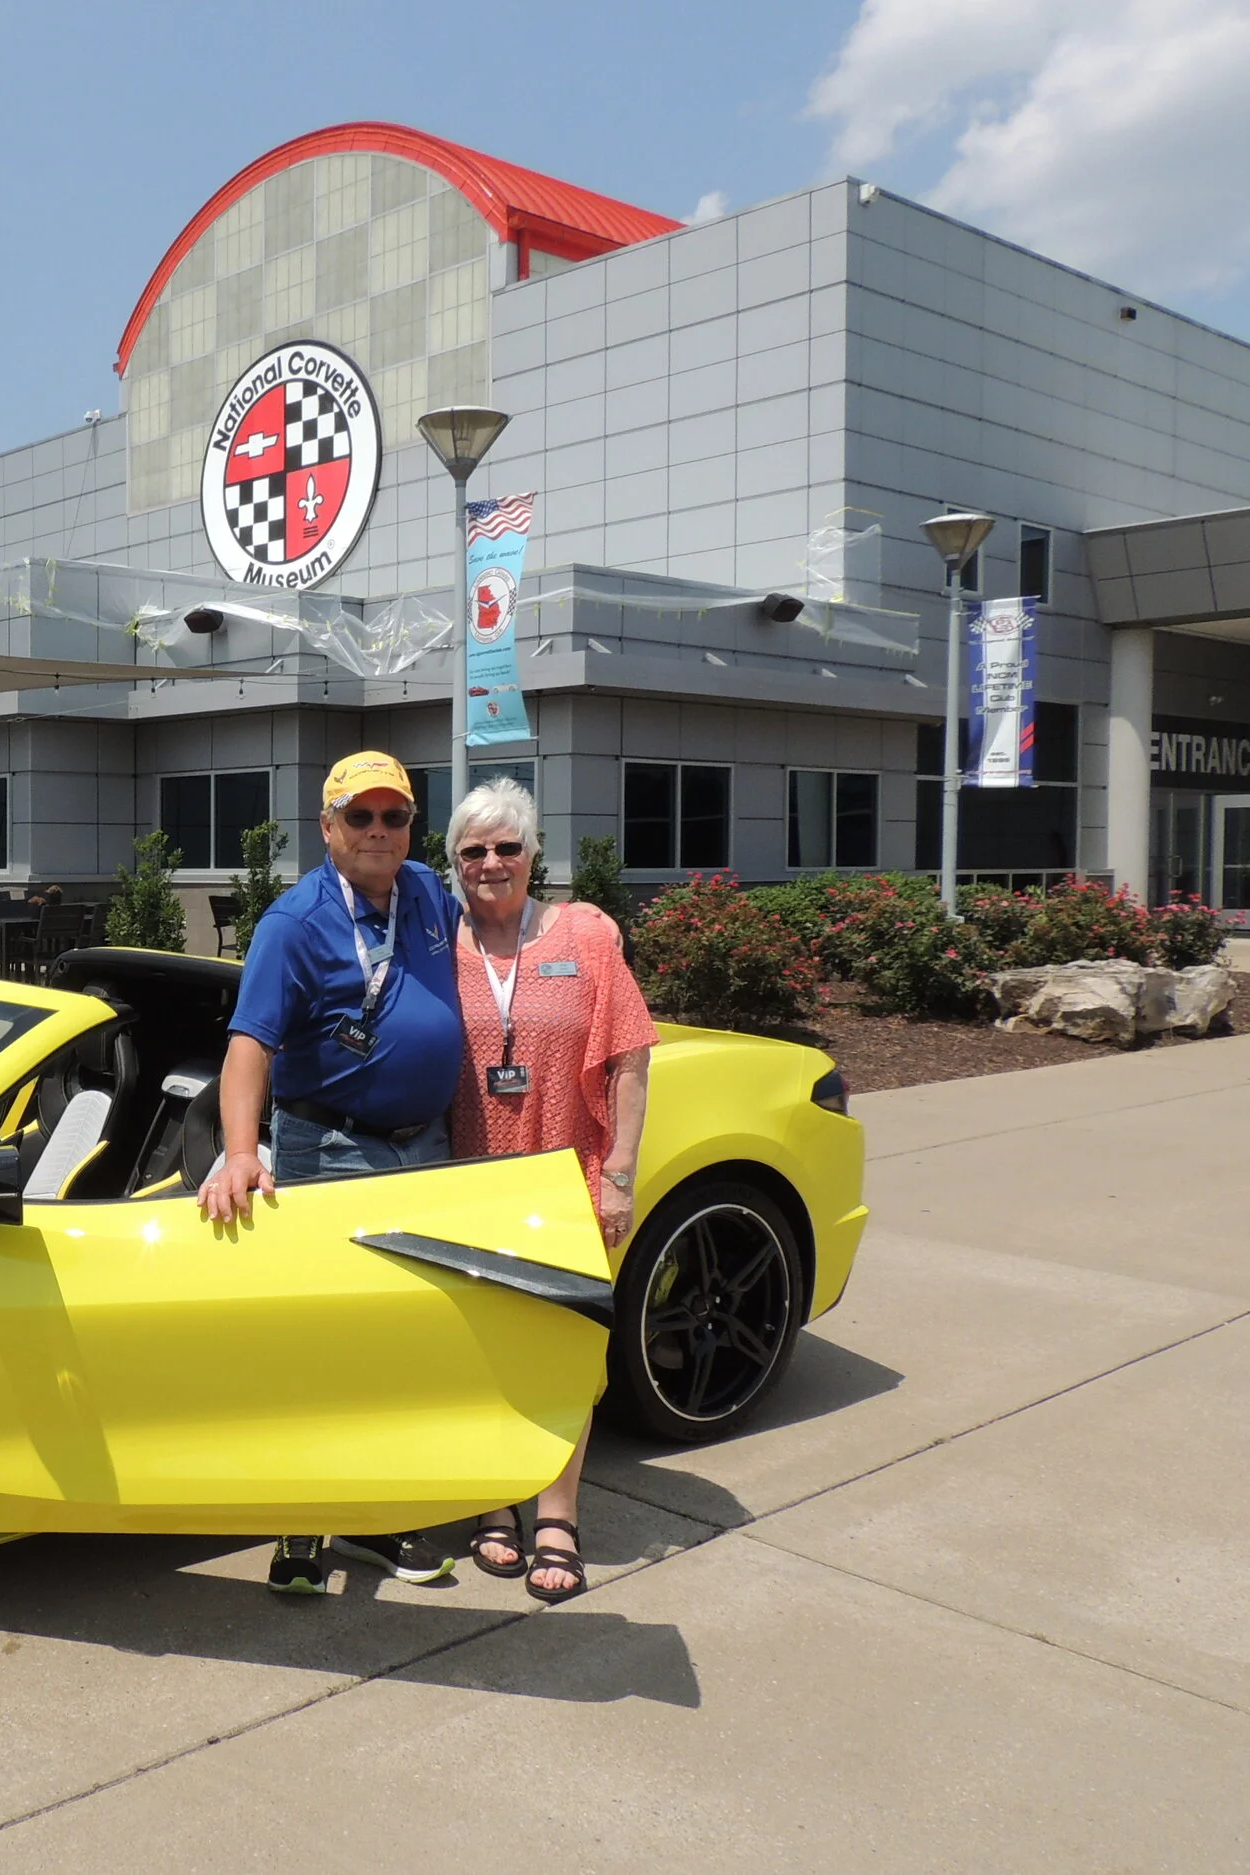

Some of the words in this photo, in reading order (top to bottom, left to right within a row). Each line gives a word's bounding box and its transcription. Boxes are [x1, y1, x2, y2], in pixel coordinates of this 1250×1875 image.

[212, 356, 282, 453] National
[287, 351, 362, 419] Corvette
[243, 550, 332, 590] Museum
[990, 659, 1029, 669] Proud
[971, 680, 1033, 693] LIFETIME
[349, 1025, 366, 1040] VIP
[497, 1070, 516, 1080] VIP
